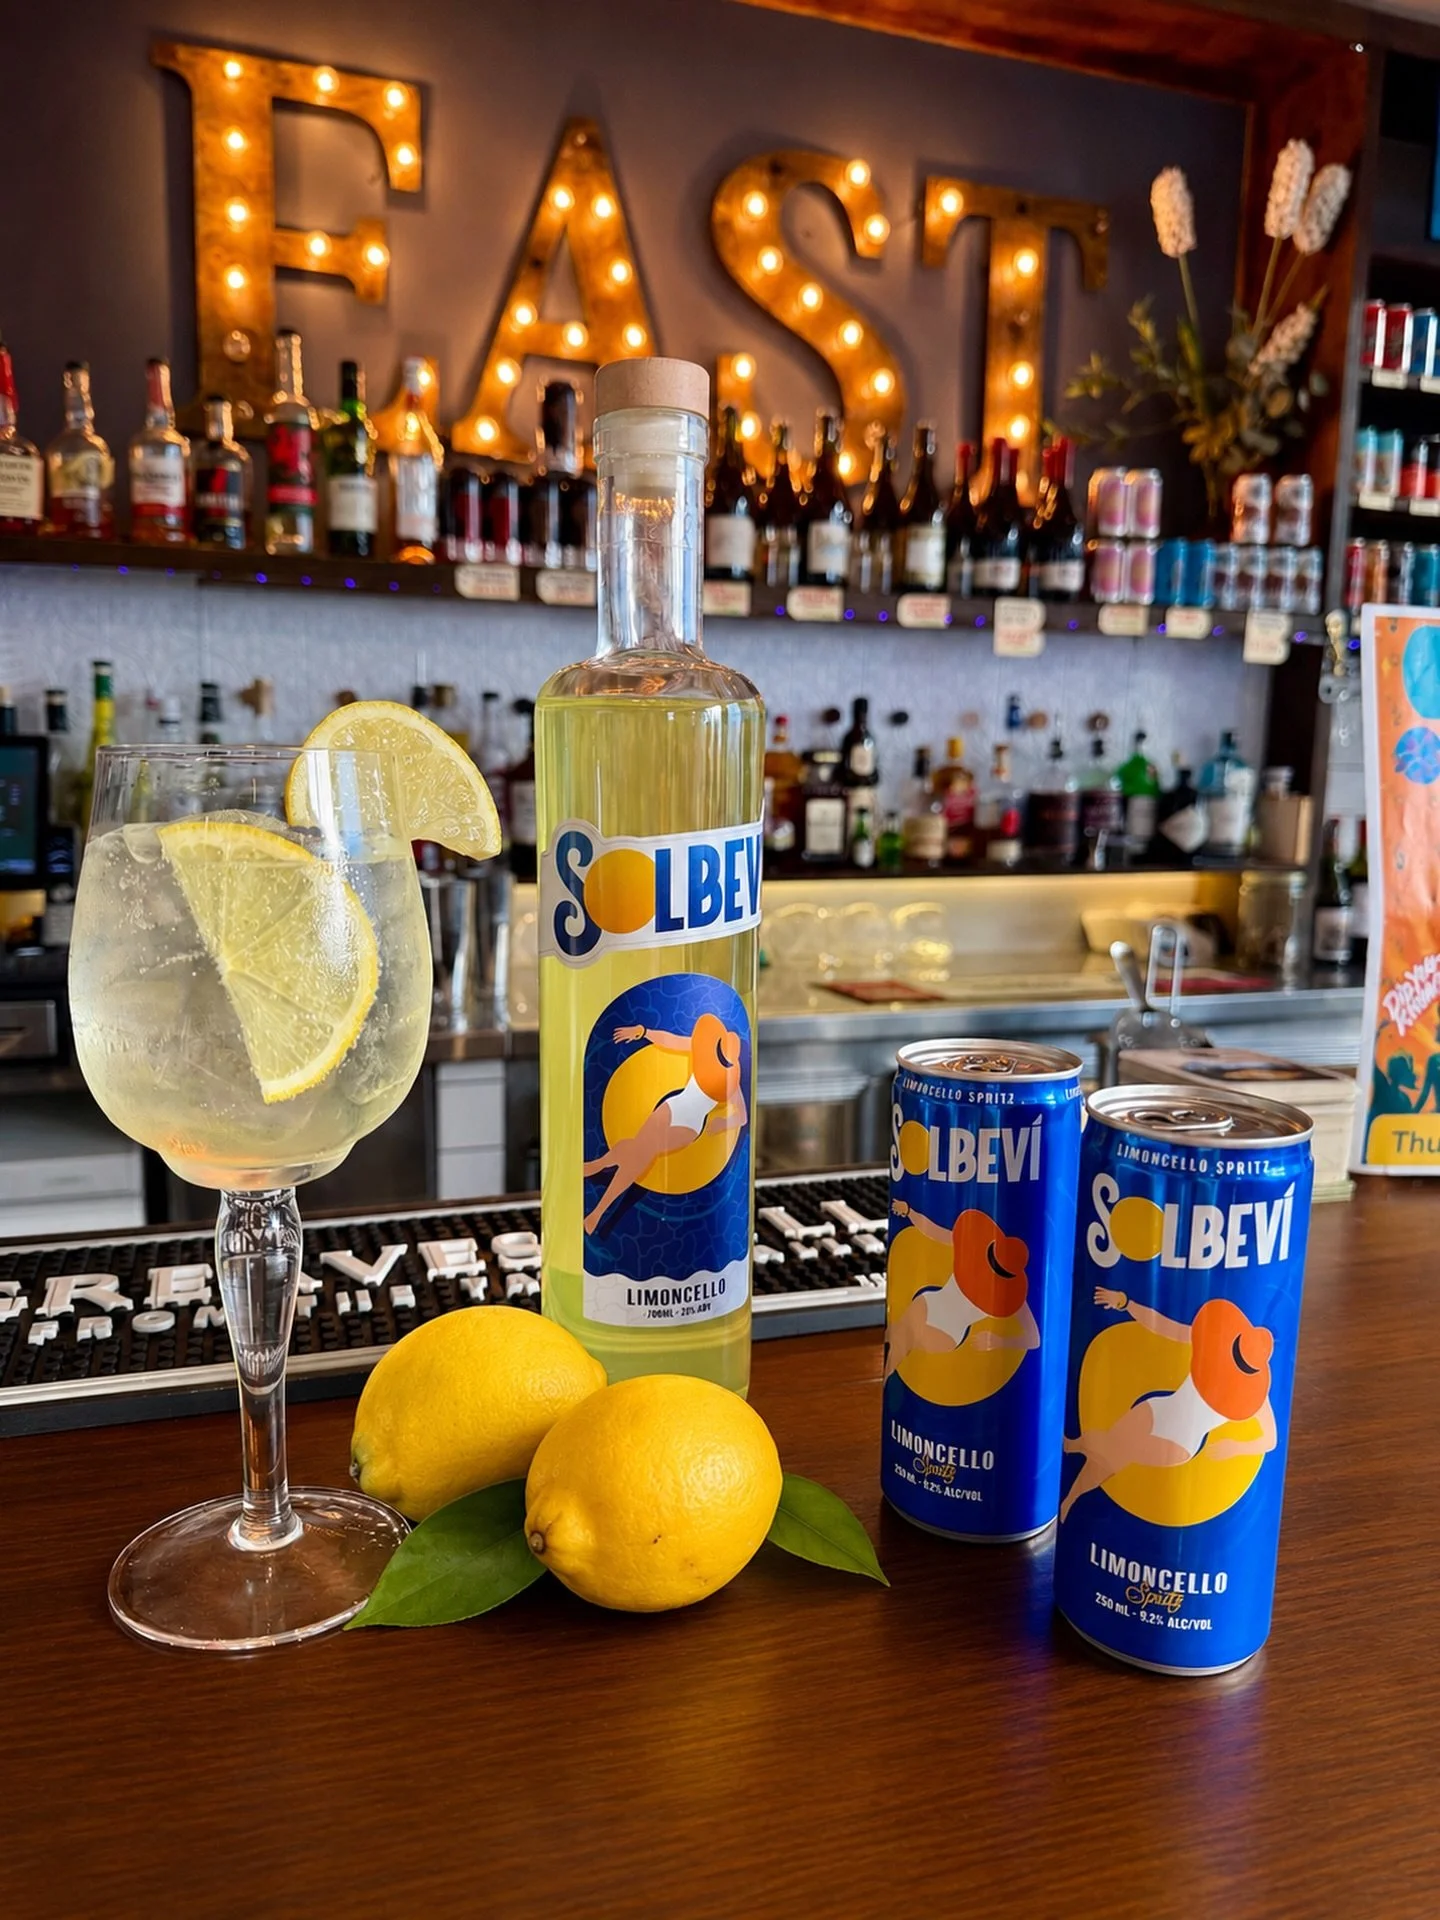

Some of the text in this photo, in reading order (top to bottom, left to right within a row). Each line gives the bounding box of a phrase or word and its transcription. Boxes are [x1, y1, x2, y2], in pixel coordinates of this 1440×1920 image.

[152, 42, 1110, 508] EAST
[969, 1091, 1014, 1104] SPRITZ
[1116, 1143, 1270, 1175] LIMONCELLO SPRITZ
[1086, 1172, 1295, 1269] SOLBEVÍ
[627, 1278, 726, 1306] LIMONCELLO
[891, 1419, 995, 1470] LIMONCELLO
[943, 1486, 984, 1502] ALC/VOL
[1090, 1542, 1229, 1595] LIMONCELLO
[1095, 1592, 1113, 1610] 250
[1167, 1617, 1213, 1631] ALC/VOL
